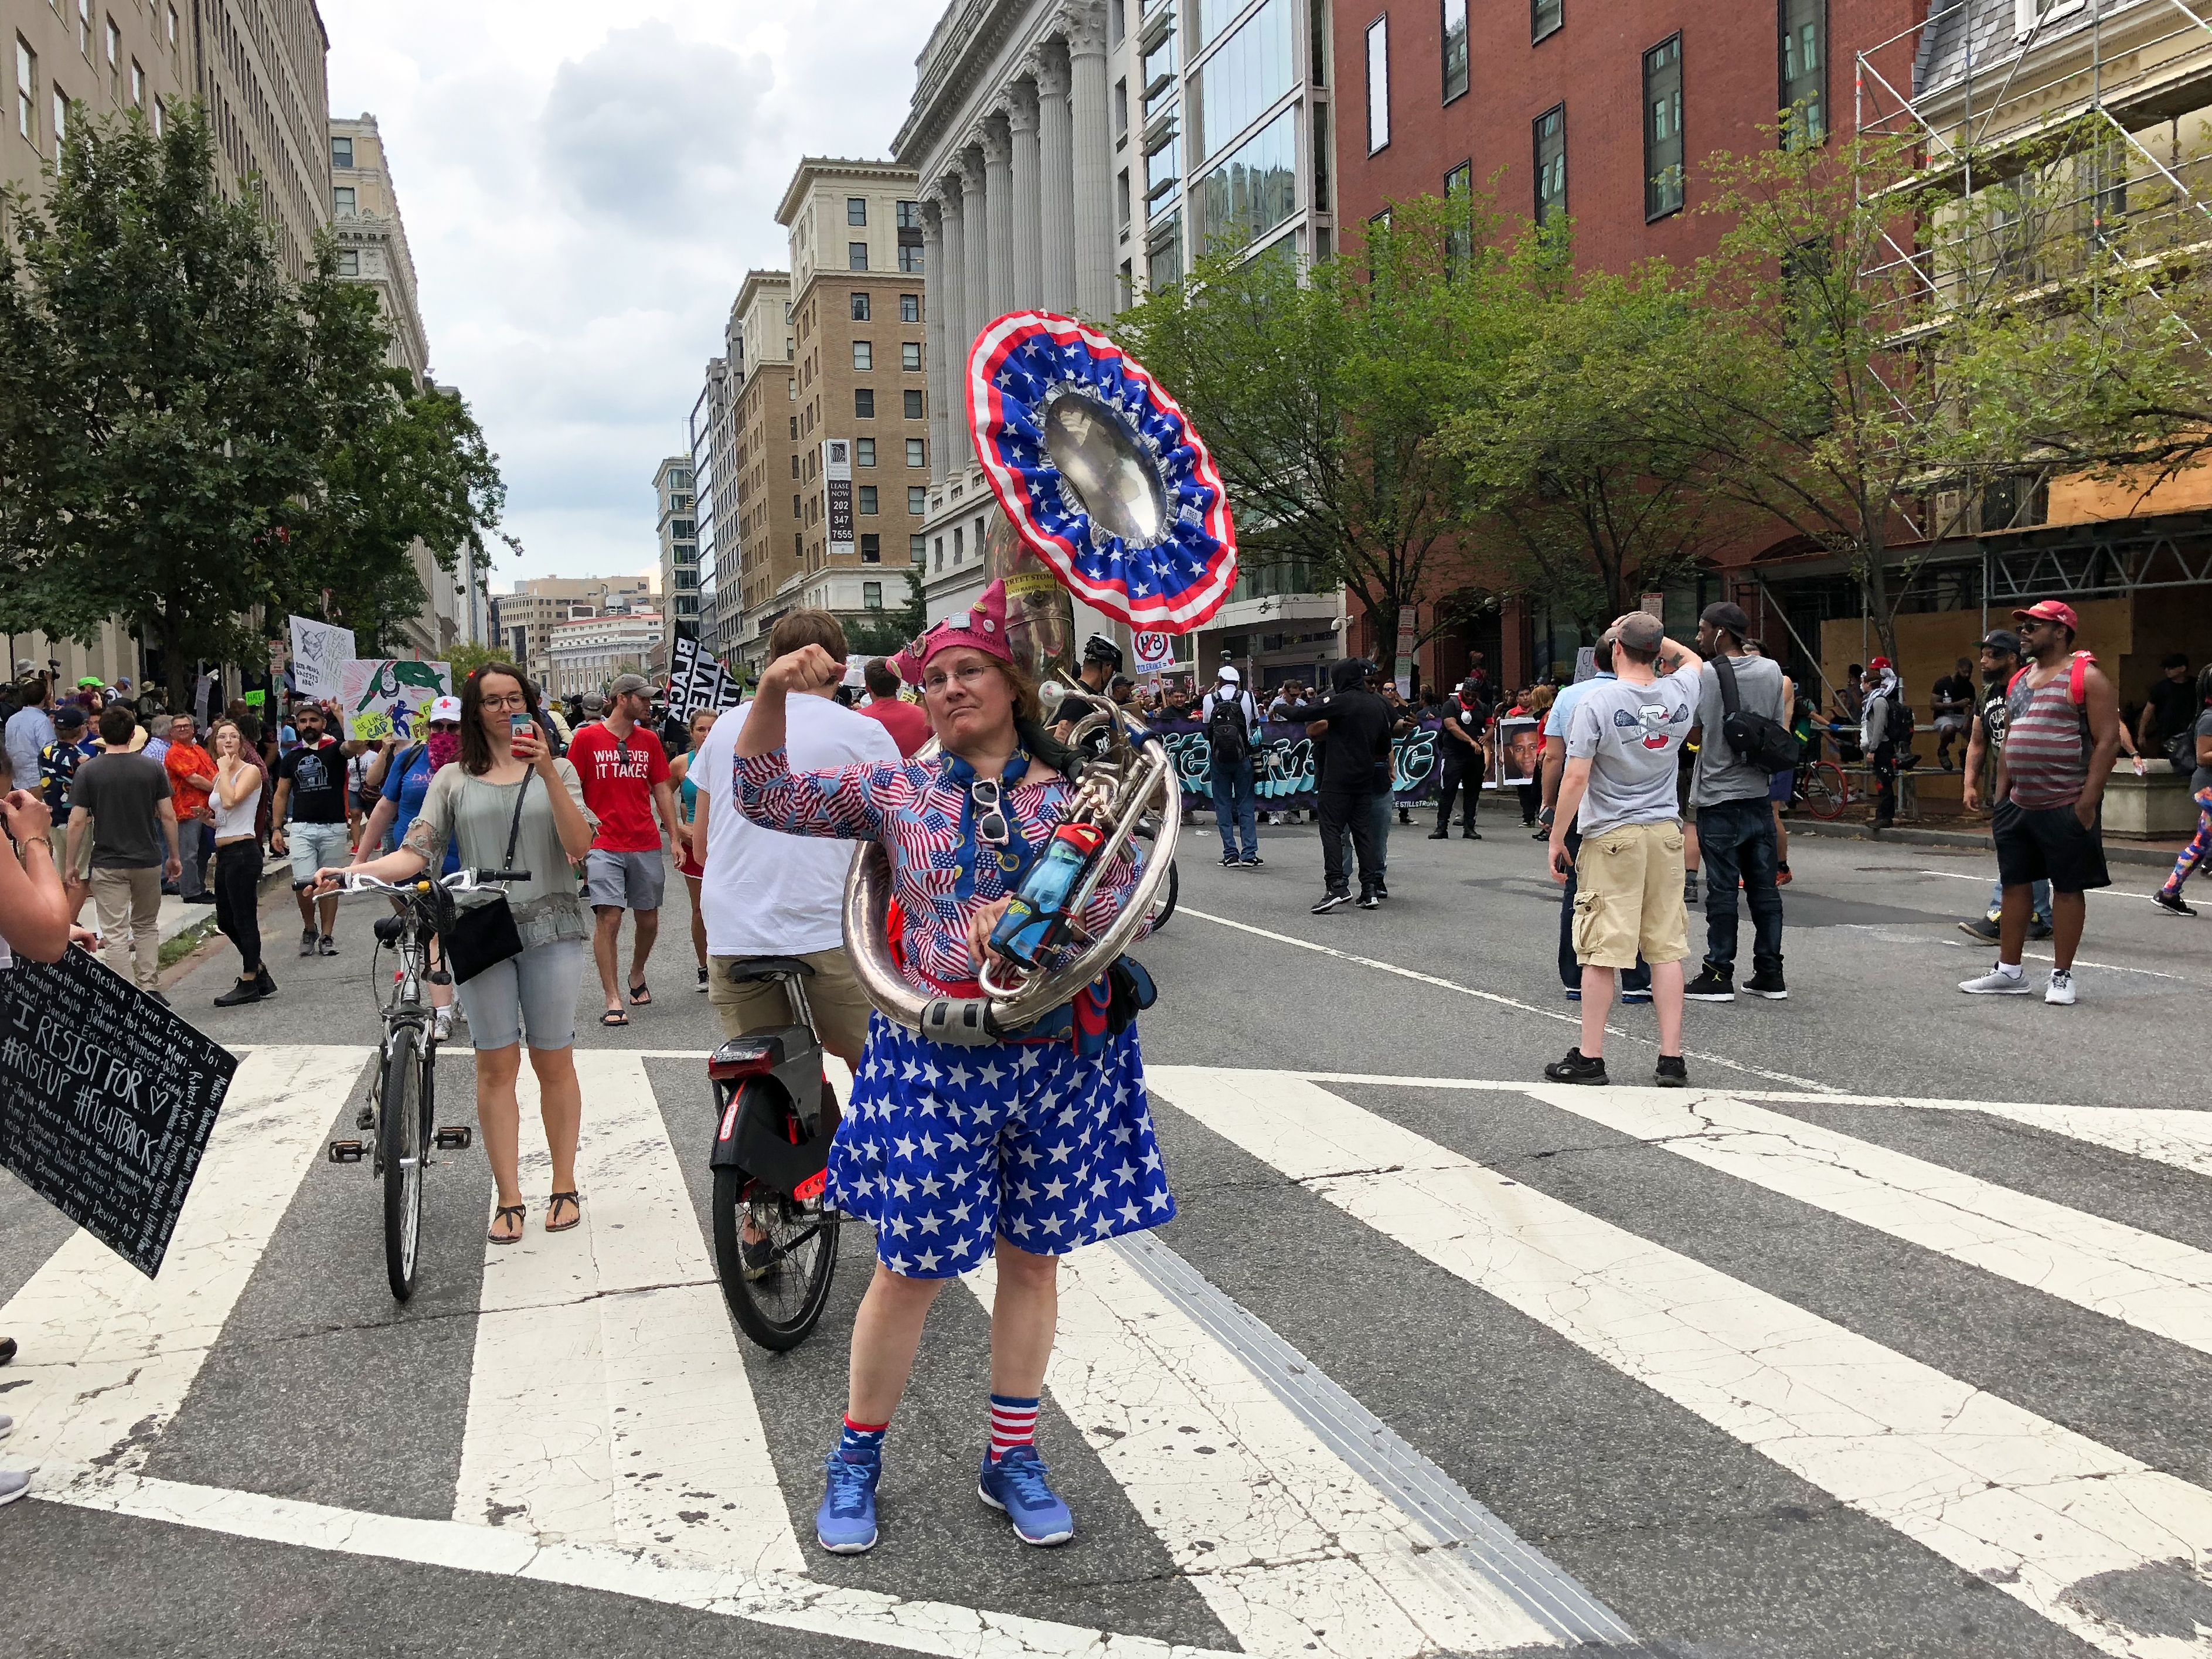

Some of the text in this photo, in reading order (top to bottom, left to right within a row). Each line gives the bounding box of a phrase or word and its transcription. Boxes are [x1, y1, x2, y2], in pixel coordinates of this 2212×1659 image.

[833, 501, 849, 510] 202
[834, 515, 849, 524] 347
[832, 530, 852, 539] 7555
[1005, 575, 1028, 587] TREET
[356, 713, 385, 732] BE LIKE
[367, 722, 388, 739] CAP
[593, 750, 649, 762] WHAEVER
[595, 763, 648, 780] IT TAKES
[25, 966, 53, 995] London
[43, 963, 86, 997] Jonathan
[139, 1024, 162, 1048] Sauce
[4, 971, 39, 1005] Michael
[45, 1000, 74, 1028] Sandra
[81, 1025, 101, 1044] Eric
[133, 1057, 152, 1077] Eric
[132, 993, 160, 1026] Devin
[166, 1018, 193, 1049] Erica
[200, 1042, 221, 1067] Joi
[12, 1000, 35, 1031] I
[35, 1015, 111, 1081] RESIST
[1, 1035, 159, 1170] #RISEUP #FIGHTBACK
[186, 1071, 203, 1108] Robert
[66, 1120, 92, 1147] Donald
[79, 1150, 111, 1182] Brandon
[93, 1200, 118, 1228] Devin
